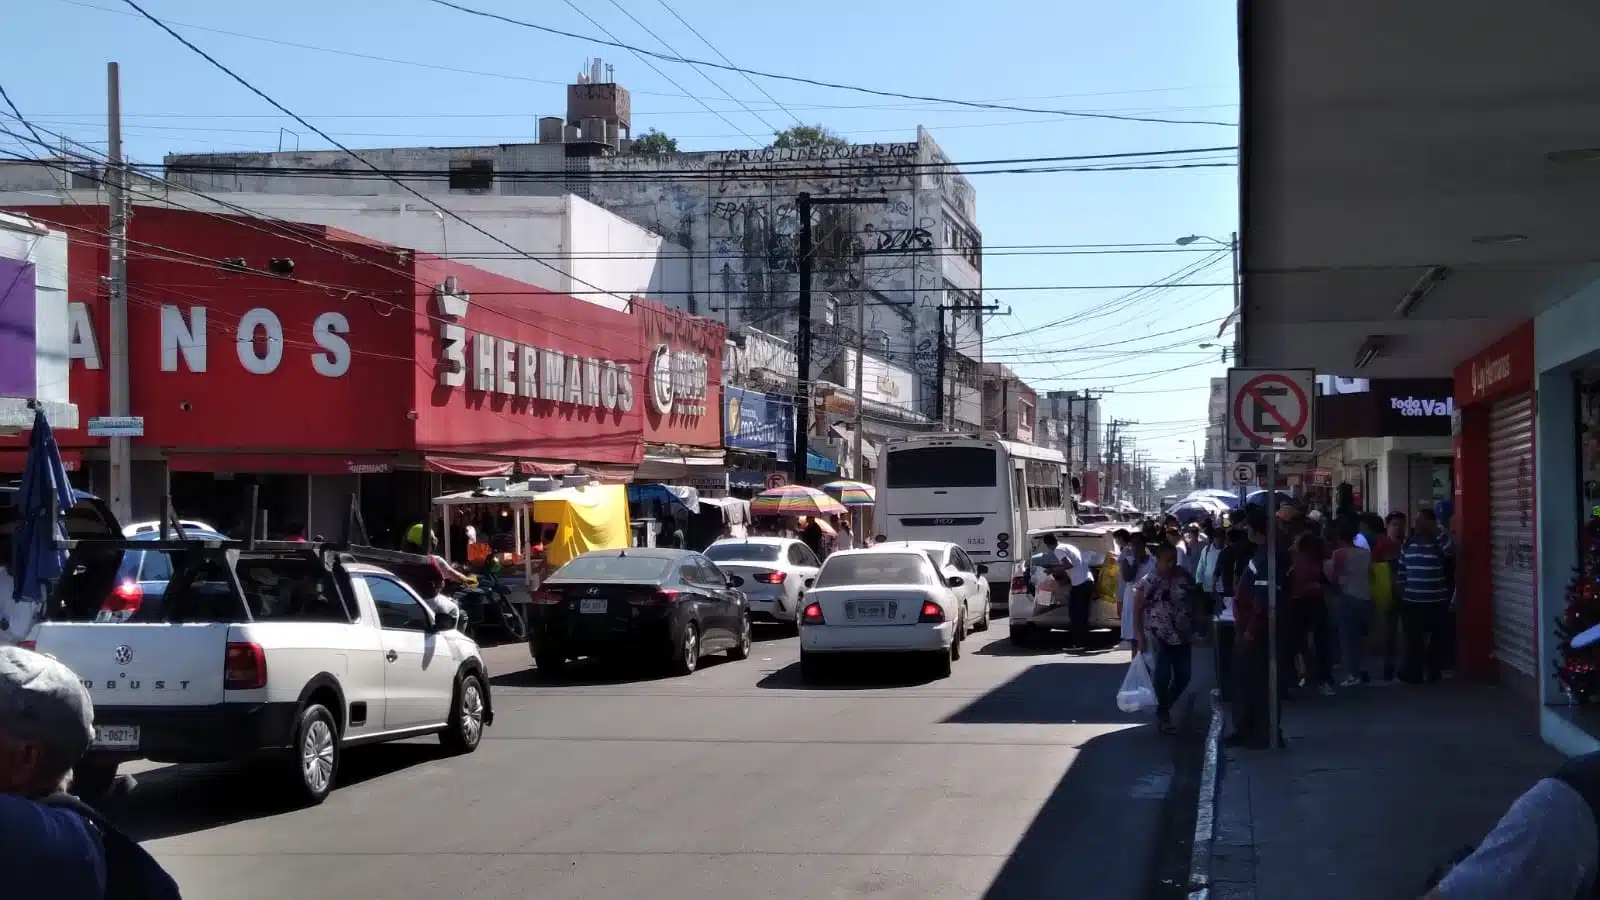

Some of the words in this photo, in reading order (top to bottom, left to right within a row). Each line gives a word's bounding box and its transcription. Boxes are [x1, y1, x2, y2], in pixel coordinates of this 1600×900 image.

[472, 333, 634, 413] HERMANOS
[1390, 396, 1421, 409] Todo
[1401, 407, 1422, 416] con
[1421, 397, 1453, 416] Val
